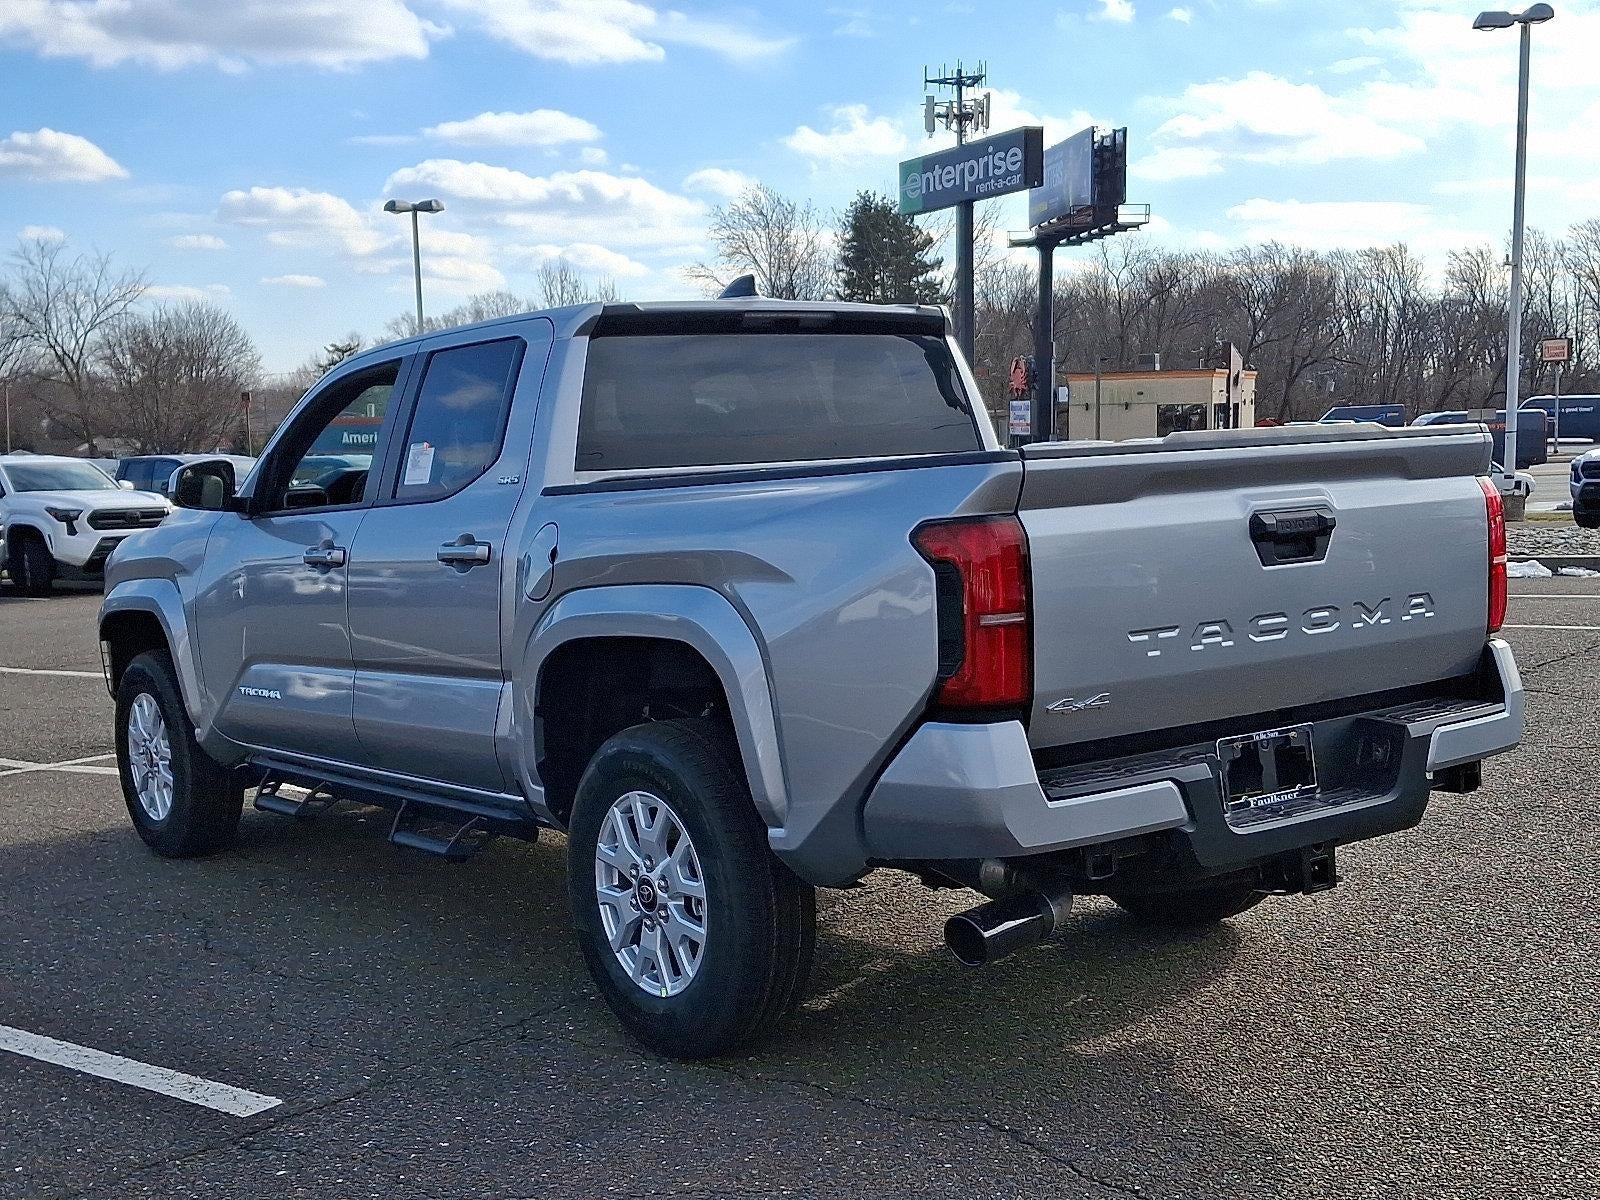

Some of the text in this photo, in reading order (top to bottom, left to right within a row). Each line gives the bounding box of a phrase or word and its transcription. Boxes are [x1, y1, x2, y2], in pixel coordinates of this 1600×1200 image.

[902, 145, 1022, 199] enterprise
[975, 174, 1021, 194] rent-a-car
[1279, 517, 1318, 532] TOYOTA
[1127, 591, 1435, 657] TACOMA
[239, 686, 281, 700] TACOMA
[1250, 791, 1299, 807] Faulkner
